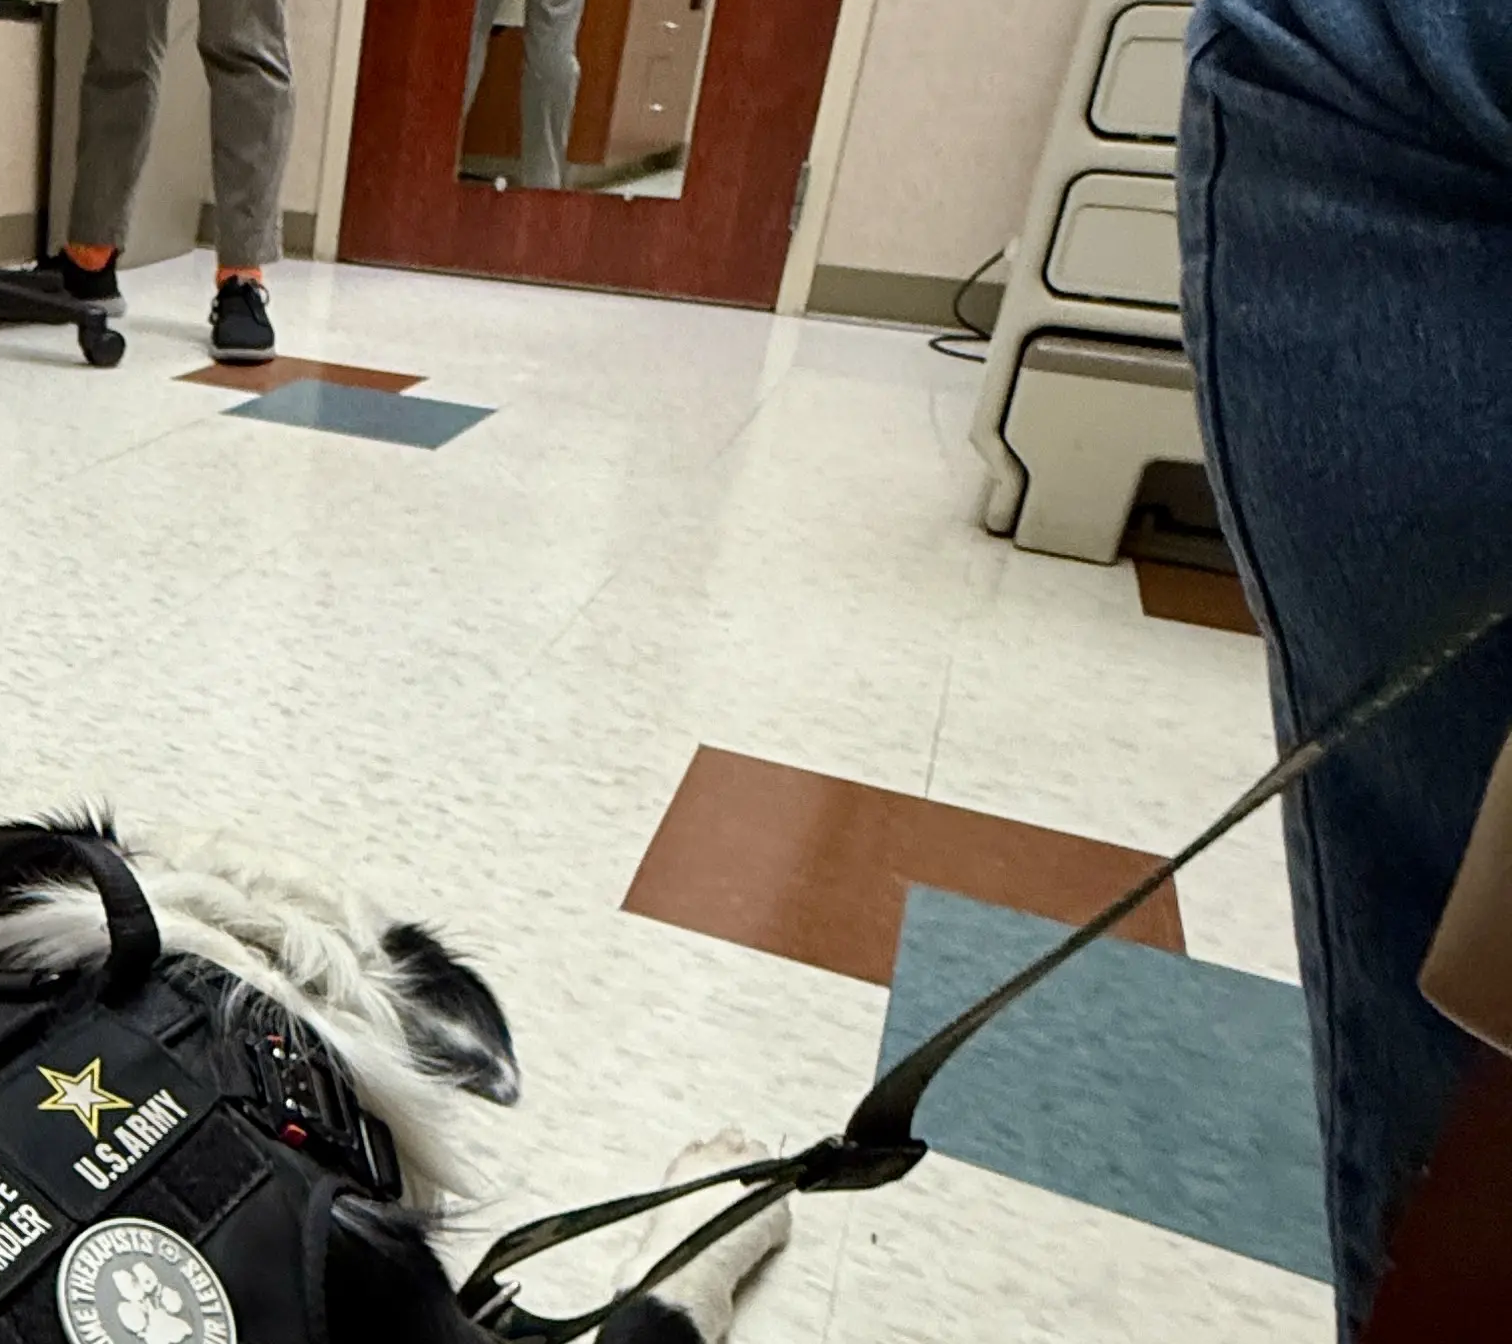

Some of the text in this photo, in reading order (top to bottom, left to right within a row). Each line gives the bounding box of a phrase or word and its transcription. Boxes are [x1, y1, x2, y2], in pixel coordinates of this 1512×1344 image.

[113, 1088, 188, 1159] ARMY
[70, 1227, 154, 1305] THERAPISTS
[180, 1257, 222, 1316] LEGS
